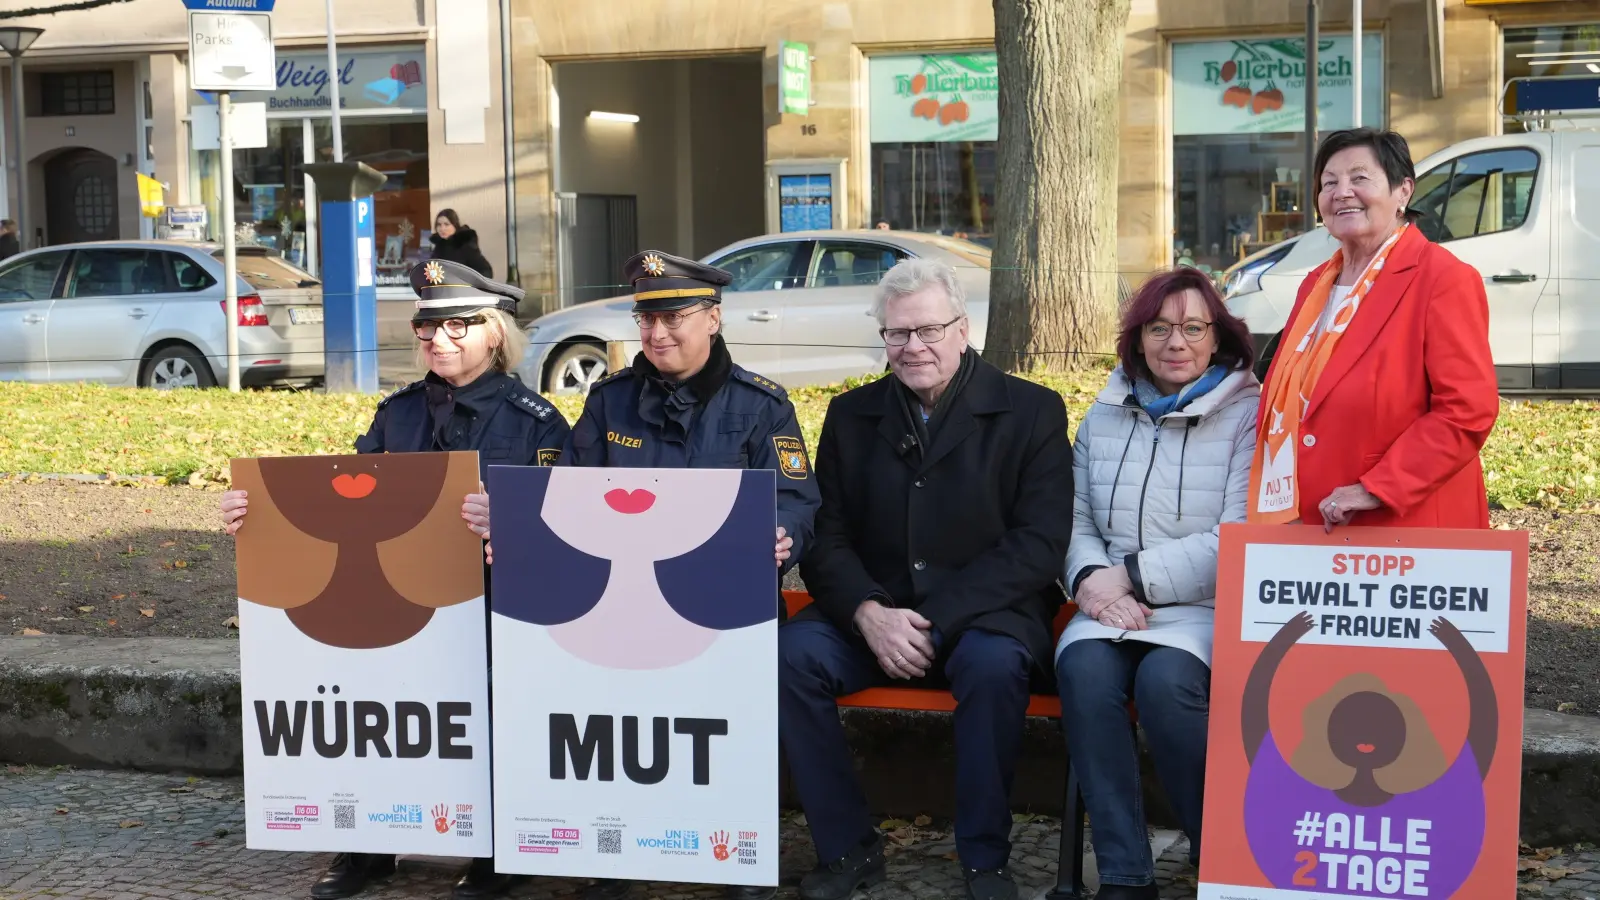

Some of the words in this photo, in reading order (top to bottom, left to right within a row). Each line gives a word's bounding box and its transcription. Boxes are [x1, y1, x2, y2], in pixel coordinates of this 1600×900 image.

[275, 58, 355, 96] Weigl
[269, 96, 347, 109] Buchhandlug
[801, 124, 817, 136] 16
[358, 201, 368, 223] P
[607, 431, 642, 449] OLIZEI
[1331, 553, 1415, 577] STOPP
[1258, 579, 1379, 608] GEWALT
[1390, 583, 1489, 612] GEGEN
[1320, 613, 1421, 639] FRAUEN
[253, 684, 473, 760] WÜRDE
[548, 712, 728, 785] MUT
[305, 807, 317, 815] 016
[392, 804, 407, 813] UN
[456, 804, 473, 813] STOPP
[368, 813, 407, 823] WOMEN
[456, 821, 473, 830] GEGEN
[456, 830, 473, 838] FRAUEN
[553, 830, 564, 838] 116
[565, 830, 578, 838] 016
[665, 829, 682, 838] UN
[738, 831, 758, 840] STOPP
[1292, 811, 1432, 855] #ALLE
[636, 838, 682, 849] WOMEN
[738, 840, 757, 848] GEWALT
[738, 848, 757, 857] GEGEN
[738, 857, 757, 865] FRAUEN
[1292, 850, 1430, 896] 2TAGE
